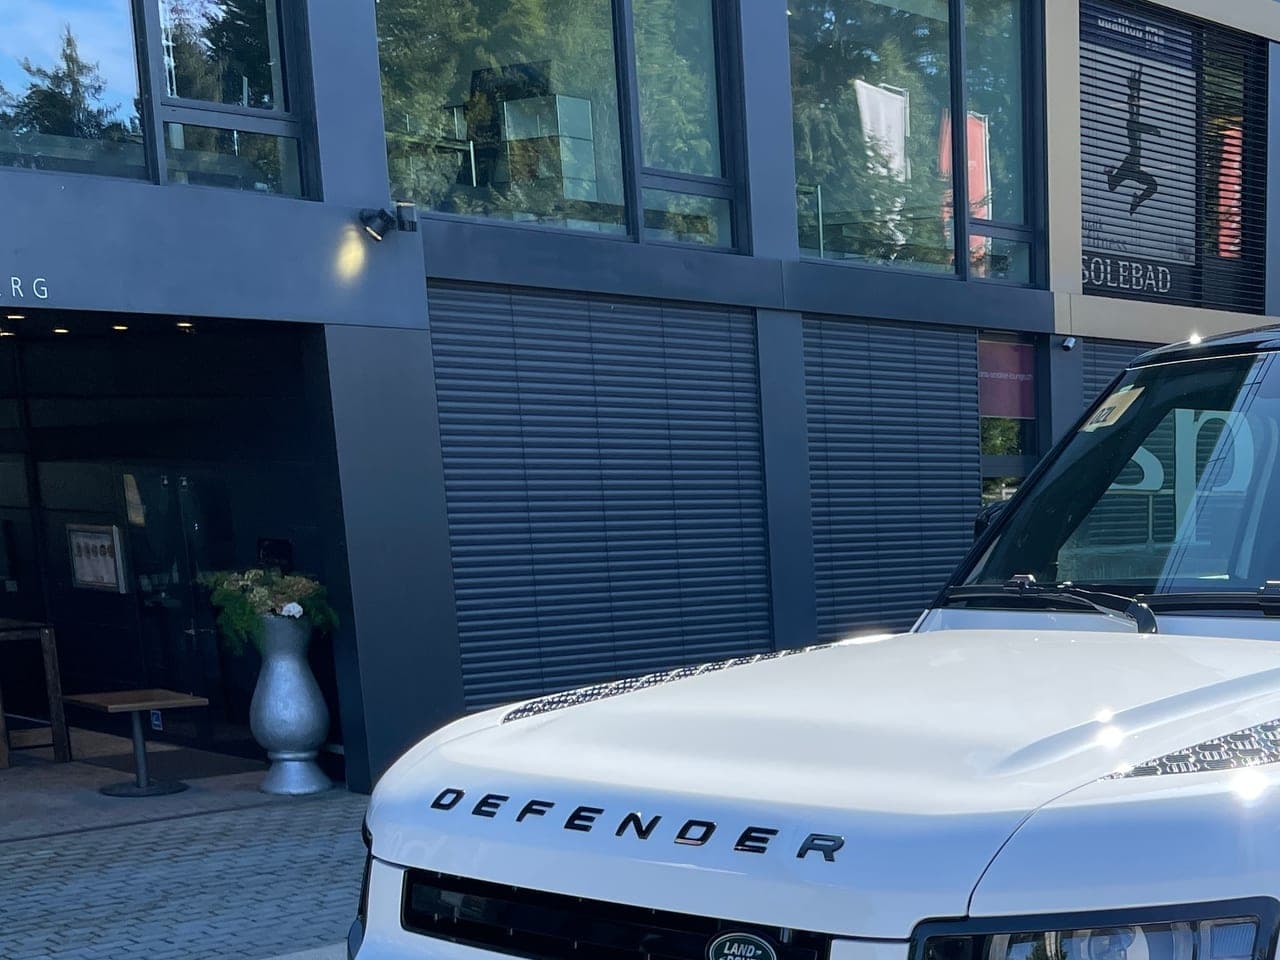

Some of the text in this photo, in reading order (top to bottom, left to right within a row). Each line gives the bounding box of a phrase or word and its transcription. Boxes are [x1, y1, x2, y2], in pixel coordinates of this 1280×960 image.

[0, 276, 48, 298] RG
[1082, 255, 1171, 293] SOLEBAD
[430, 787, 846, 862] DEFENDER
[723, 941, 756, 957] LAND
